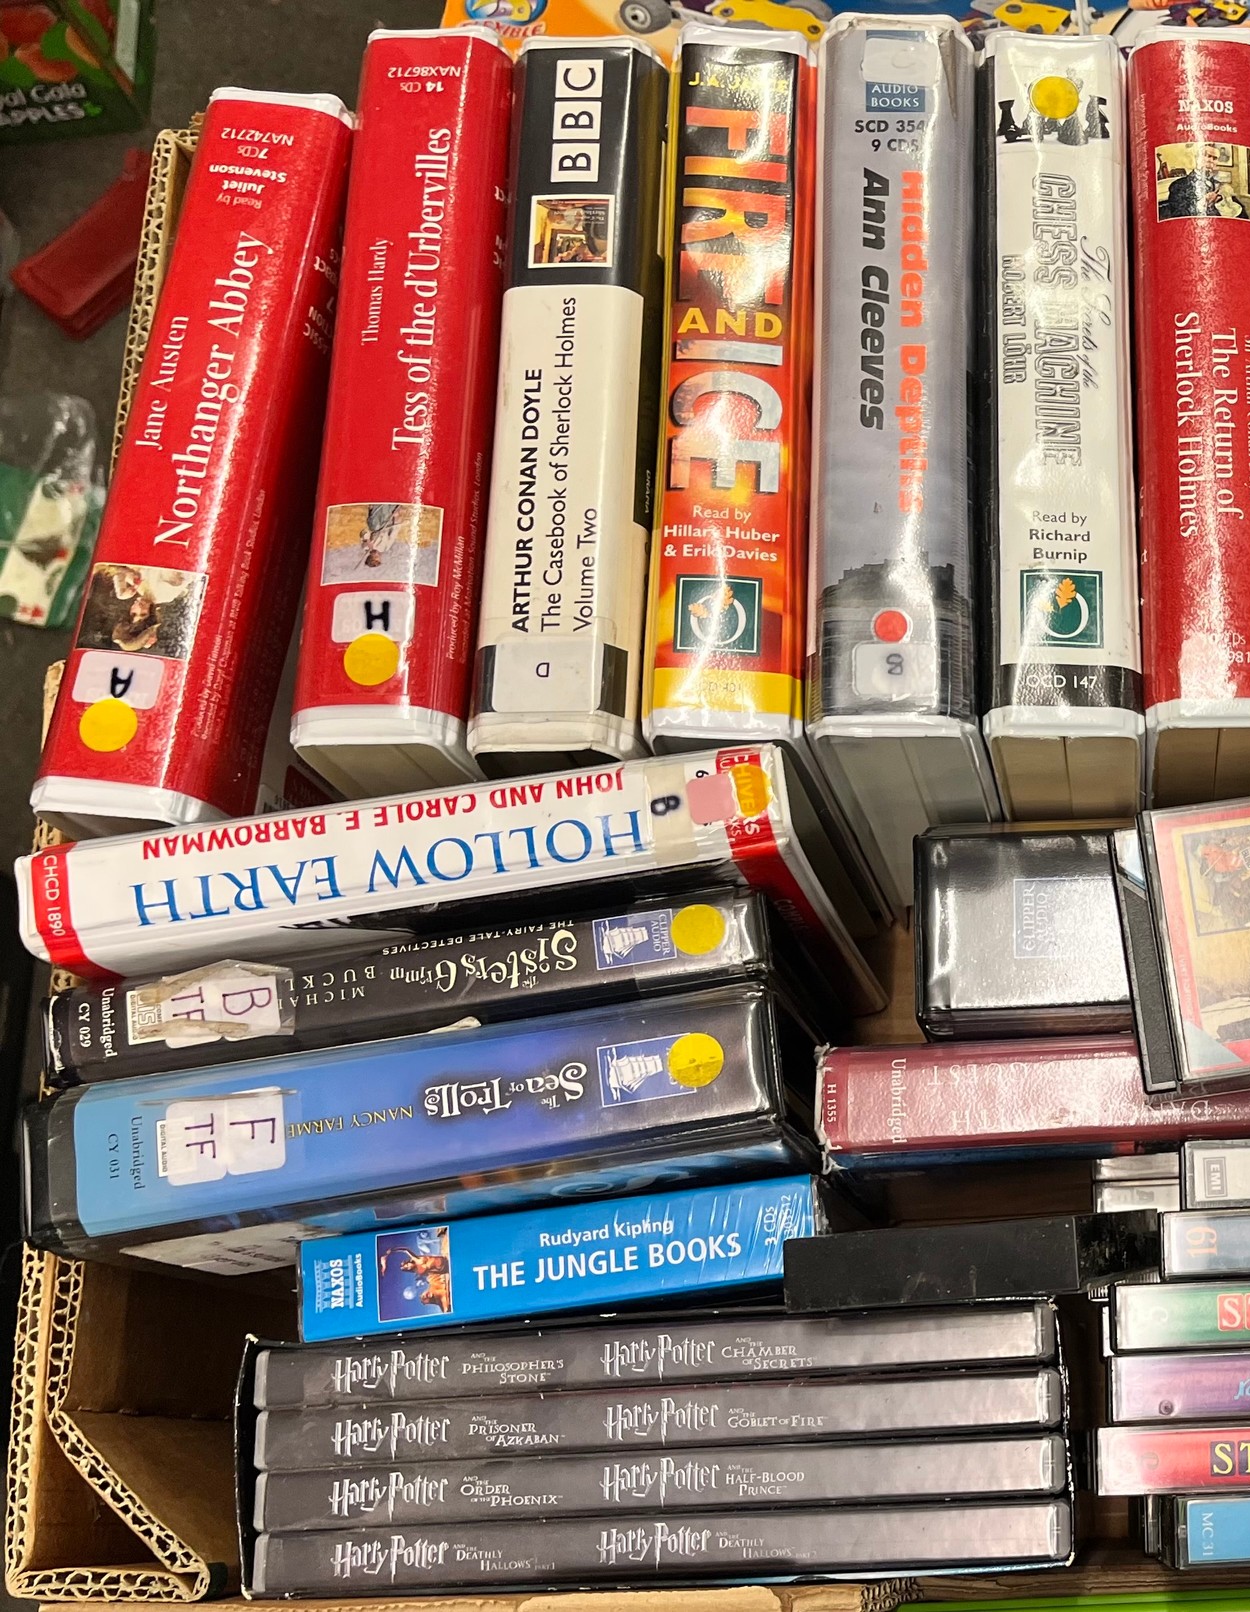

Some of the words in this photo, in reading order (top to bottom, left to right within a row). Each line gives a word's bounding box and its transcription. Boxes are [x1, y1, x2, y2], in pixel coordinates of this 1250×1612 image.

[387, 66, 461, 78] NAX86712
[871, 84, 918, 95] AUDIO
[556, 65, 598, 174] BBC
[870, 97, 919, 108] BOOKS
[1178, 99, 1234, 114] NAXOS
[854, 120, 889, 133] SCD
[895, 120, 926, 133] 354
[1176, 122, 1239, 134] AudioBooks
[209, 164, 288, 183] Stevenson
[678, 106, 789, 305] FIRE
[863, 167, 890, 251] Ann
[900, 170, 929, 328] Hidden
[1031, 172, 1079, 290] CHESS
[368, 237, 394, 281] Hardy
[1002, 255, 1026, 327] ROBERT
[361, 283, 387, 346] Thomas
[400, 301, 436, 347] the
[553, 296, 577, 368] Holmes
[677, 307, 784, 339] AND
[150, 315, 189, 393] Austen
[397, 349, 432, 385] of
[859, 264, 890, 431] Cleeves
[1174, 312, 1203, 428] Sherlock
[1211, 327, 1239, 378] The
[153, 343, 241, 549] Northanger
[207, 230, 275, 338] Abbey
[522, 369, 543, 440] DOYLE
[135, 399, 168, 451] Jane
[391, 390, 430, 451] Tess
[550, 374, 573, 457] Sherlock
[669, 340, 784, 494] ICE
[1212, 387, 1239, 480] Return
[517, 446, 538, 532] CONAN
[1177, 437, 1204, 538] Holmes
[1215, 489, 1244, 520] of
[577, 508, 598, 550] Two
[692, 505, 728, 519] Read
[1032, 511, 1066, 524] Read
[543, 487, 567, 586] Casebook
[723, 545, 778, 562] Davies
[1029, 528, 1091, 543] Richard
[1032, 548, 1088, 564] Burnip
[511, 537, 534, 633] ARTHUR
[573, 558, 596, 632] Volume
[364, 600, 390, 632] H
[540, 592, 562, 632] The
[1073, 675, 1098, 689] 147
[490, 783, 545, 809] AND
[557, 767, 625, 800] JOHN
[374, 793, 477, 828] CAROLE
[142, 814, 328, 861] BARROWMAN
[367, 809, 648, 894] HOLLOW
[129, 854, 347, 926] EARTH
[99, 987, 118, 1058] Unabridged
[526, 1061, 588, 1104] Sea
[350, 1105, 414, 1126] NANCY
[129, 1115, 146, 1190] Unabridged
[538, 1224, 611, 1248] Rudyard
[613, 1216, 675, 1241] Kipling
[473, 1264, 526, 1292] THE
[534, 1247, 643, 1285] JUNGLE
[647, 1232, 742, 1268] BOOKS
[331, 1355, 389, 1394] Harry
[388, 1349, 451, 1399] Potter
[461, 1358, 565, 1376] PHILOSOPHER'S
[600, 1340, 657, 1377] Harry
[655, 1333, 717, 1382] Potter
[720, 1345, 798, 1359] CHAMBER
[330, 1419, 389, 1457] Harry
[389, 1411, 452, 1462] Potter
[468, 1422, 537, 1436] PRISONER
[494, 1432, 561, 1448] AZKABAN
[459, 1482, 511, 1497] ORDER
[489, 1493, 559, 1507] PHOENIX
